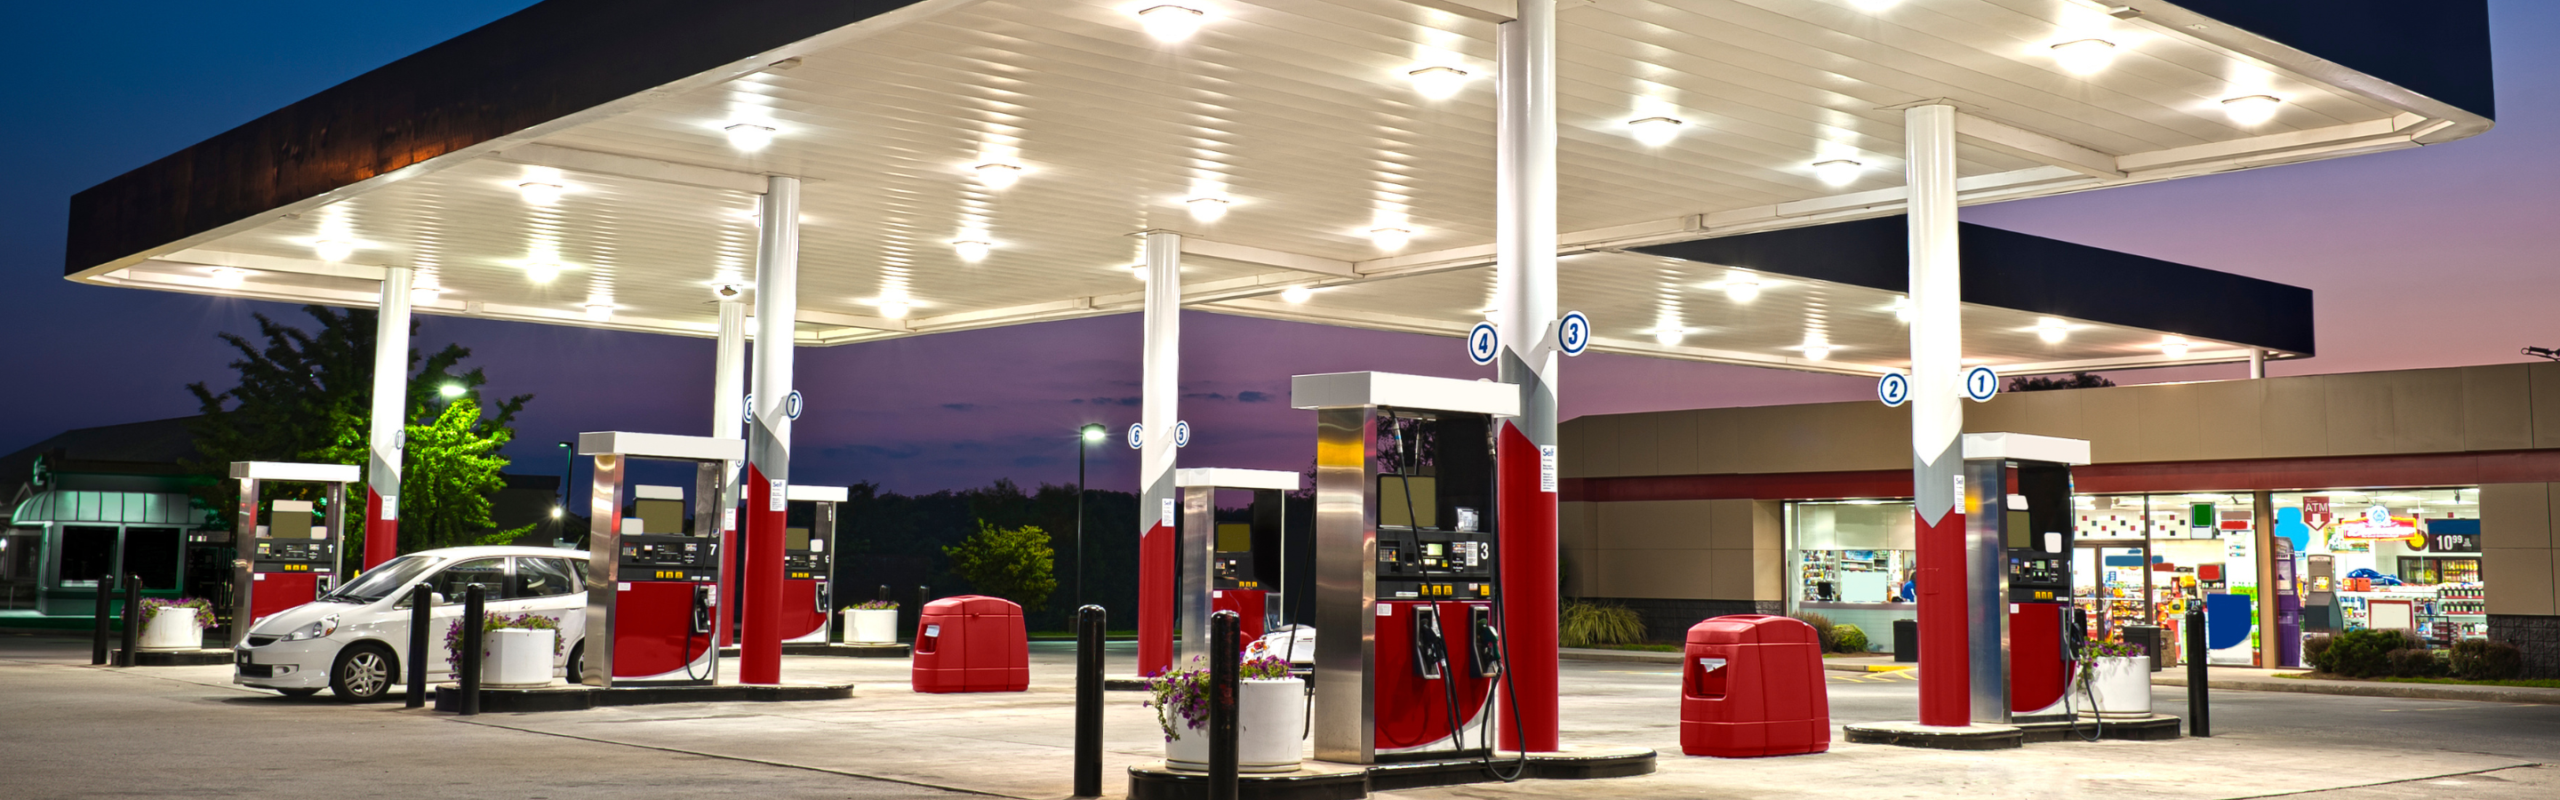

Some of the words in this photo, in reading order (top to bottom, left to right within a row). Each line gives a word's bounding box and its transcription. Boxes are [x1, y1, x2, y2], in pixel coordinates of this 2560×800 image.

[1568, 323, 1578, 345] 3
[1478, 333, 1488, 354] 4
[1889, 380, 1898, 398] 2
[1978, 375, 1985, 393] 1
[791, 398, 797, 413] 7
[1134, 430, 1139, 442] 6
[1178, 428, 1184, 441] 5
[1542, 447, 1555, 457] Self
[2305, 502, 2328, 513] ATM
[709, 543, 718, 556] 7
[1480, 542, 1489, 560] 3
[2066, 560, 2072, 573] 1
